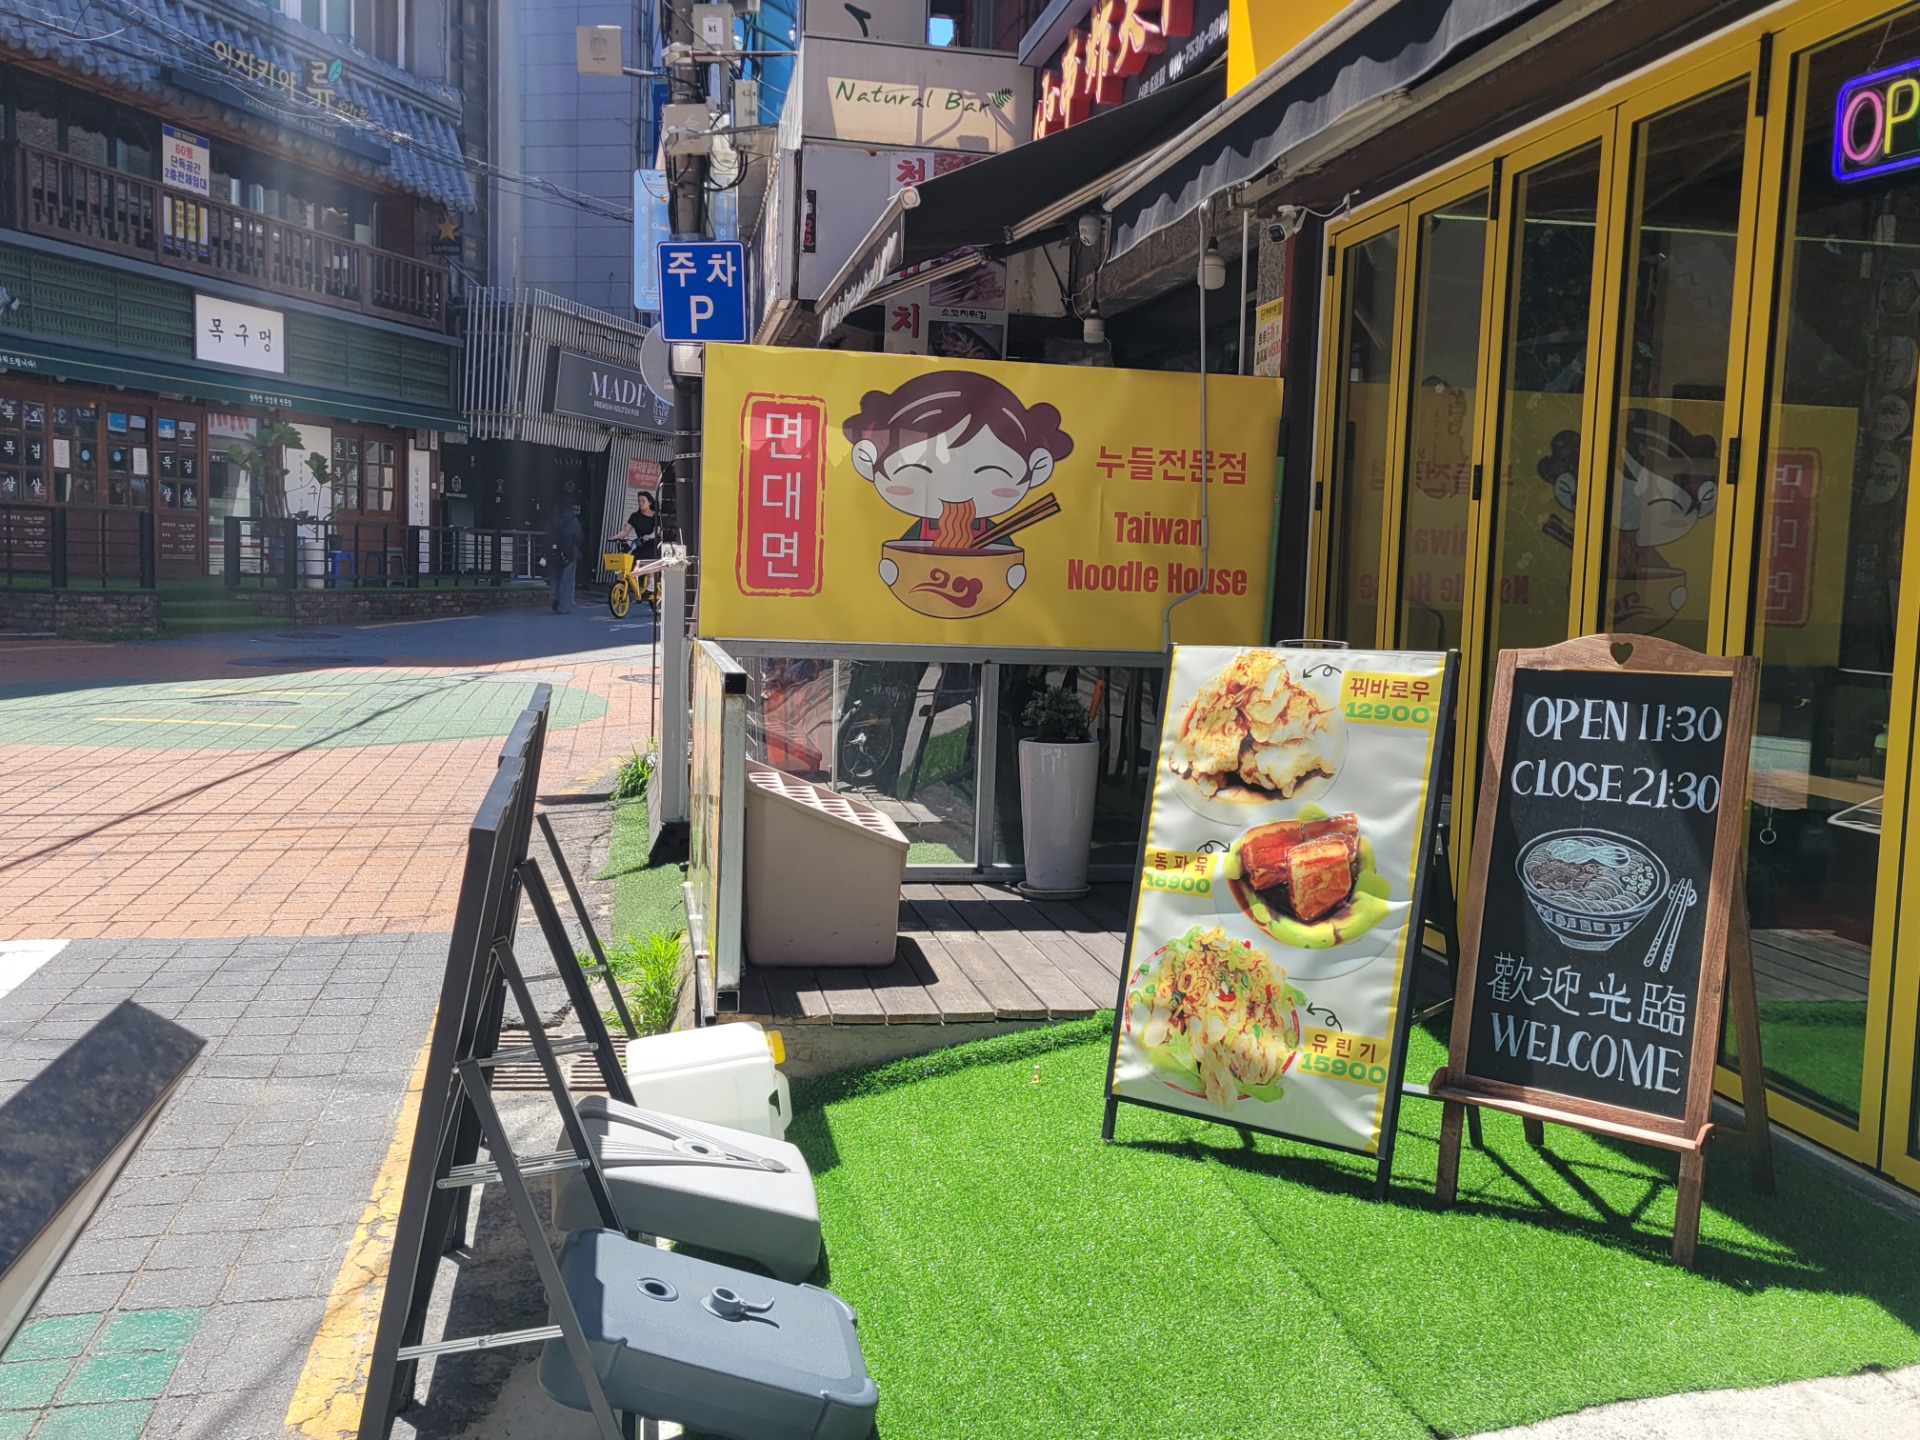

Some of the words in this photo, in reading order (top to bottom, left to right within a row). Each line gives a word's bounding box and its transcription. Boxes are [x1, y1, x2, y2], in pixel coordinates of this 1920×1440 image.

[707, 24, 718, 34] kt
[213, 39, 297, 102] 이자카야
[835, 81, 931, 108] Natural
[944, 92, 991, 117] Bar
[667, 250, 737, 287] 주차
[690, 295, 714, 334] P
[208, 318, 272, 353] 목구멍
[588, 370, 649, 409] MADE
[1095, 444, 1247, 487] 누들전문점
[761, 411, 803, 579] 면대면
[1114, 511, 1203, 548] Taiwan
[1067, 559, 1160, 595] Noodle
[1167, 562, 1247, 597] House
[1350, 677, 1431, 703] 꿔바로우
[1345, 702, 1430, 724] 12900
[1526, 696, 1629, 742] OPEN
[1639, 704, 1722, 743] 11:30
[1511, 758, 1623, 803] CLOSE
[1627, 767, 1721, 814] 21:30
[1153, 854, 1208, 875] 동파육
[1486, 951, 1687, 1038] 歡迎光臨
[1311, 1033, 1377, 1064] 유린기
[1491, 1011, 1683, 1095] WELCOME
[1302, 1053, 1387, 1085] 15900
